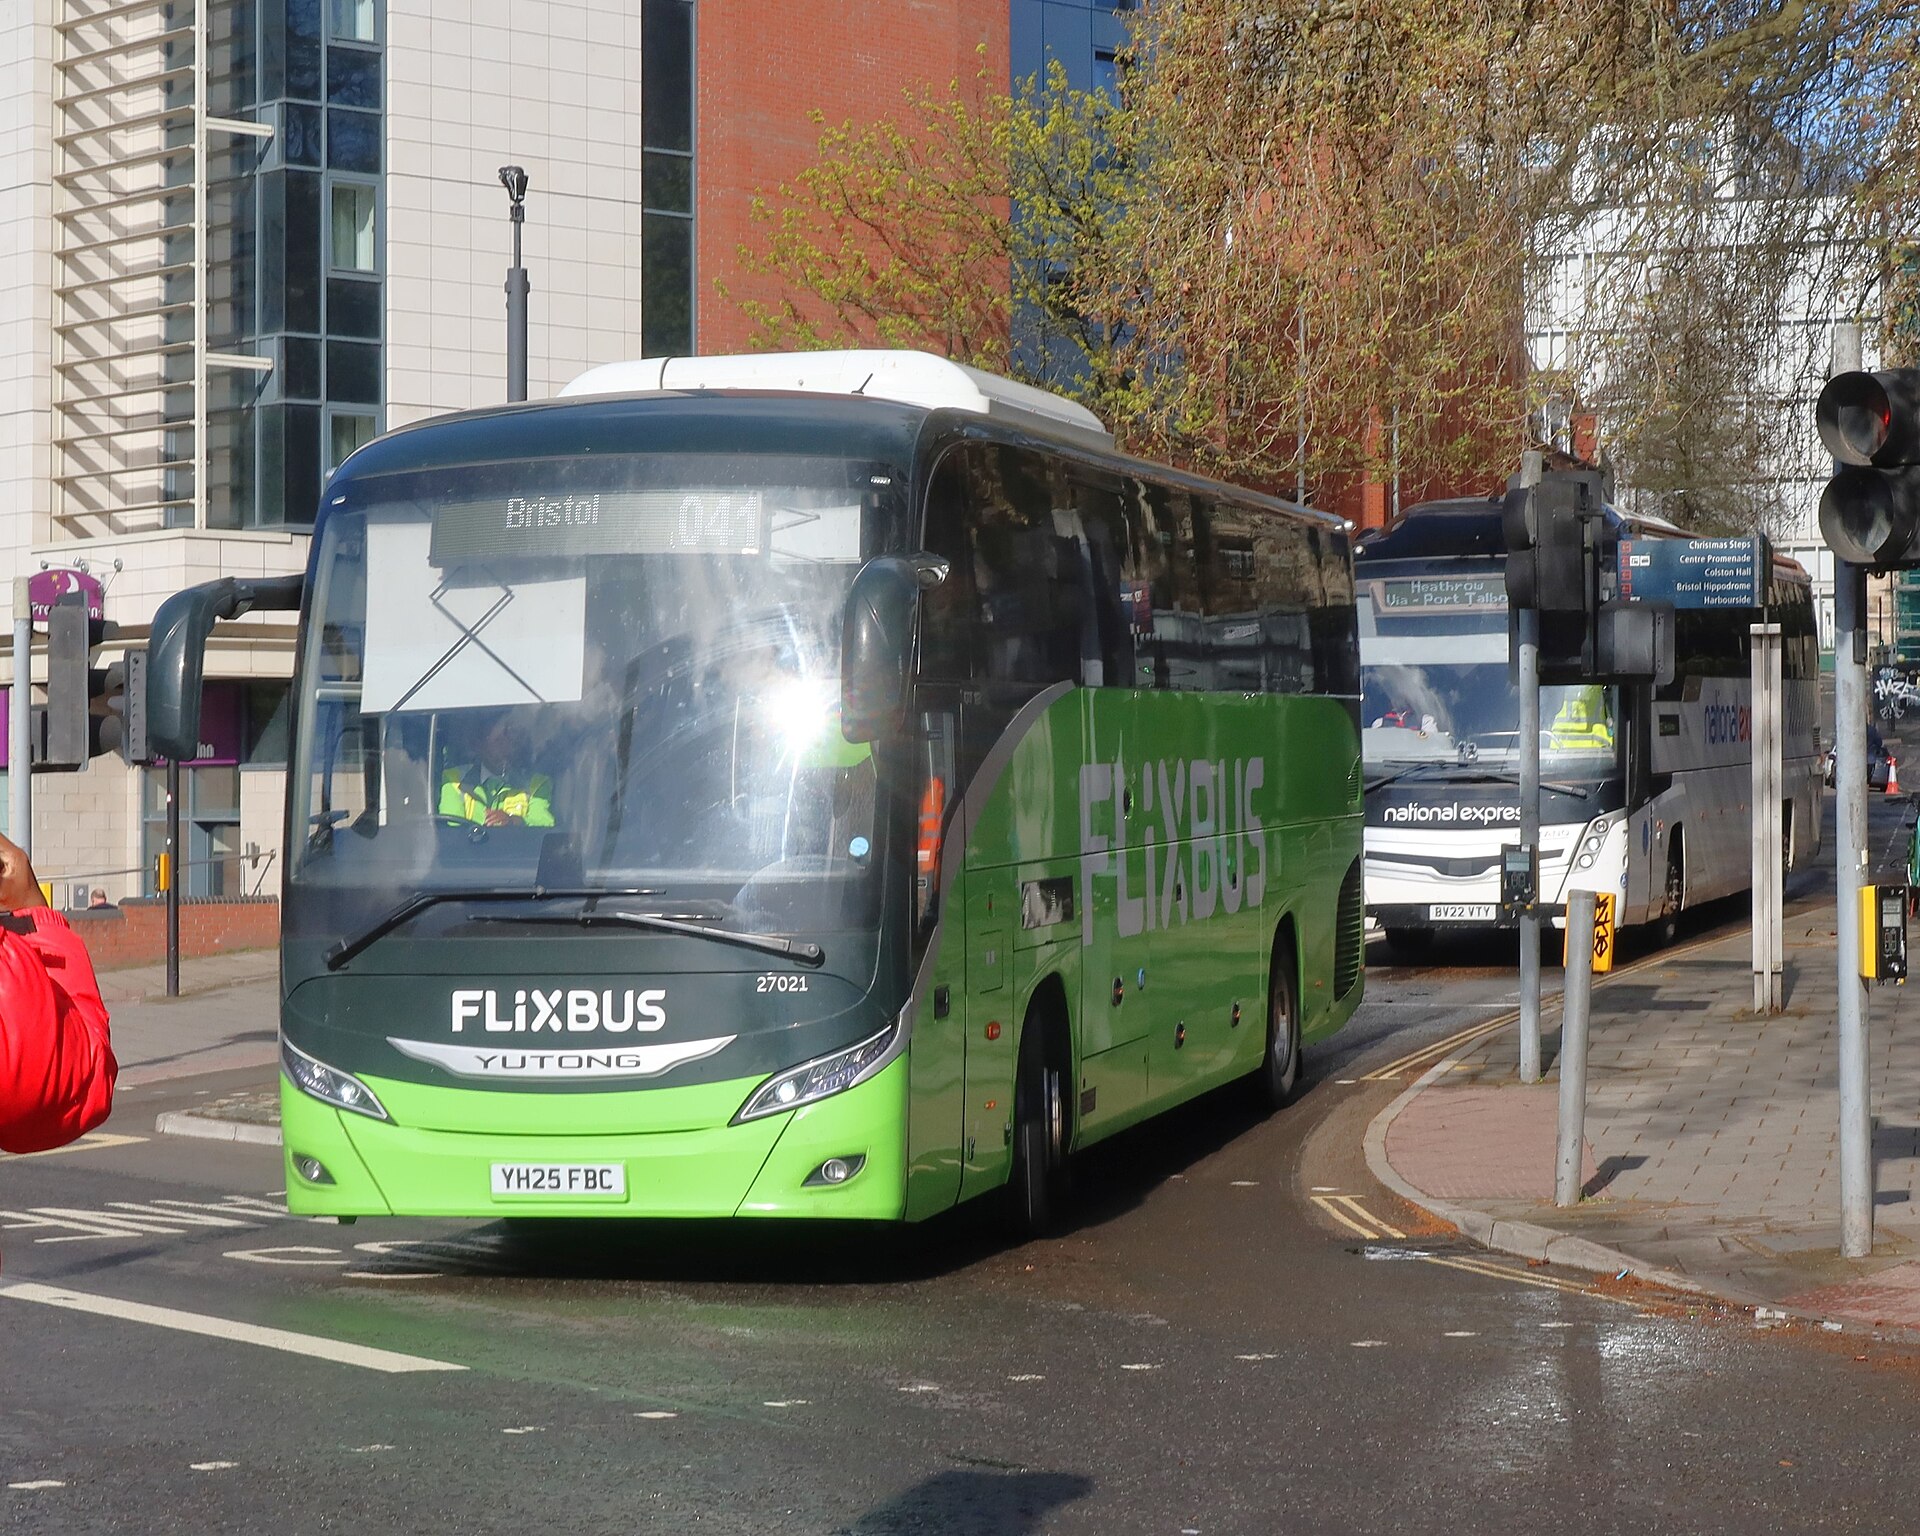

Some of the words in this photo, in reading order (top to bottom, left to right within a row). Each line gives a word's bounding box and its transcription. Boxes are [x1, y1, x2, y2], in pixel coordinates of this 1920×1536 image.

[505, 493, 601, 529] Bristol
[675, 495, 760, 549] 041
[1689, 540, 1727, 549] Christmas
[1730, 539, 1751, 550] Steps
[1680, 555, 1705, 564] Centre
[1707, 553, 1751, 564] Promenade
[1705, 568, 1733, 577] Colston
[1736, 567, 1751, 576] Hall
[1411, 581, 1484, 594] Heathrow
[1677, 582, 1701, 591] Bristol
[1704, 581, 1751, 592] Hippodrome
[1386, 594, 1408, 607] Via
[1424, 593, 1460, 606] Port
[1465, 592, 1508, 604] Talbo
[1704, 595, 1751, 604] Harbourside
[1384, 803, 1458, 822] national
[1079, 756, 1266, 946] FLiXBUS
[1435, 907, 1465, 919] BV22
[1467, 906, 1491, 918] VTY
[757, 975, 809, 993] 27021
[450, 989, 667, 1033] FLiXBUS
[475, 1054, 641, 1069] YUTONG
[500, 1169, 561, 1190] YH25
[569, 1168, 613, 1190] FBC
